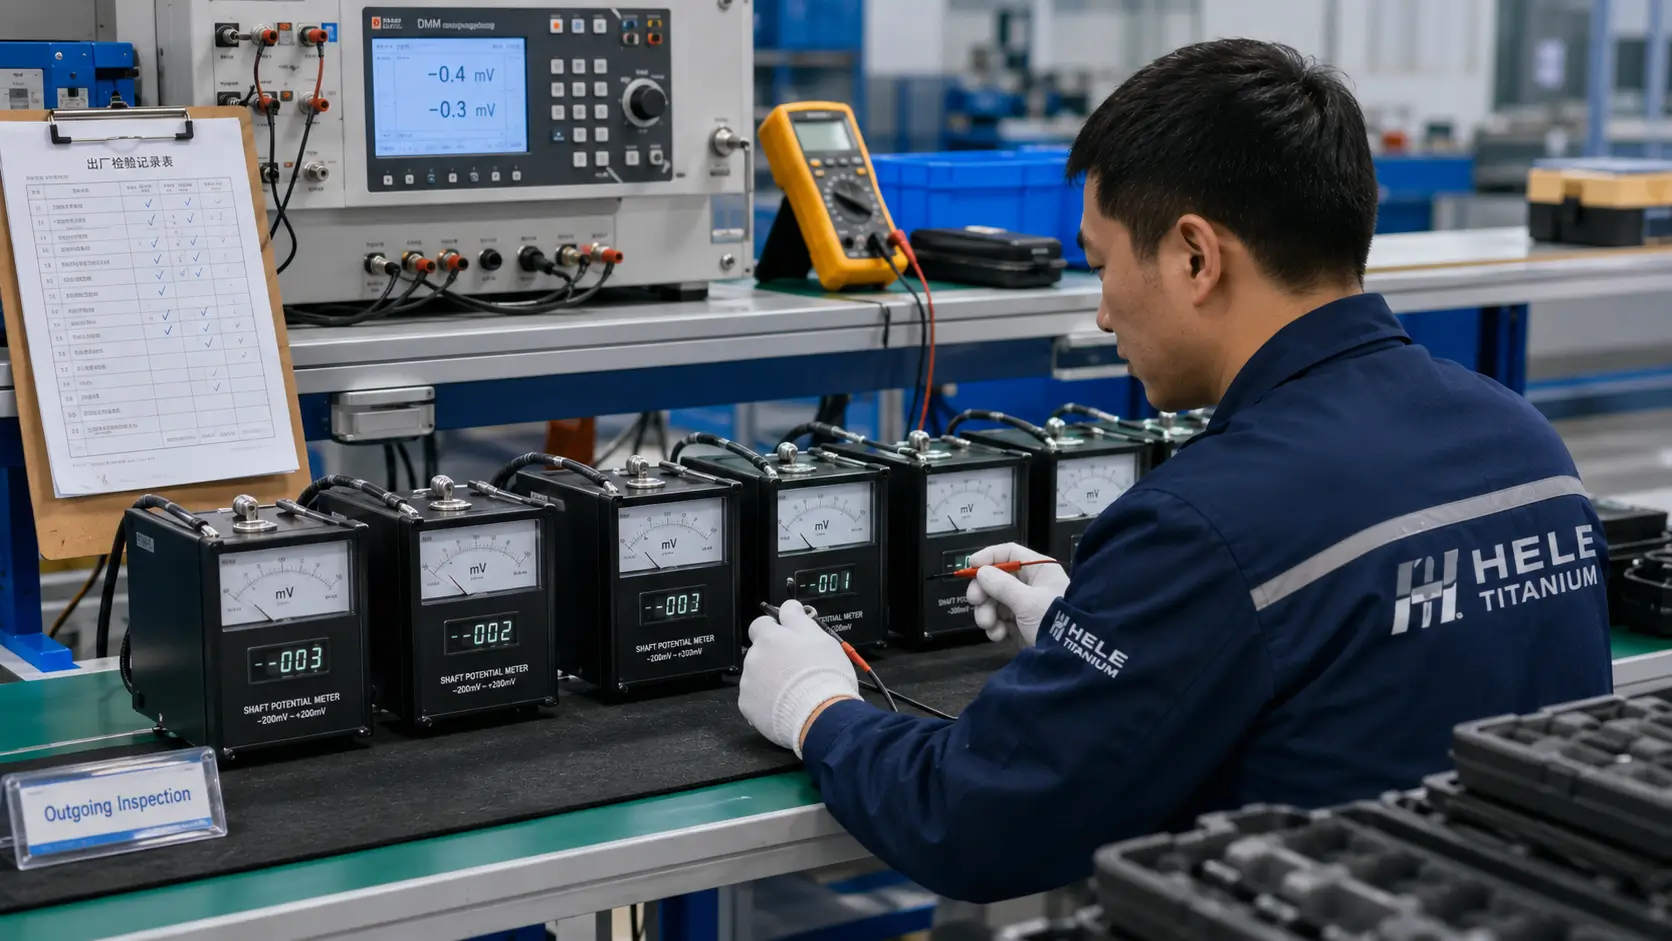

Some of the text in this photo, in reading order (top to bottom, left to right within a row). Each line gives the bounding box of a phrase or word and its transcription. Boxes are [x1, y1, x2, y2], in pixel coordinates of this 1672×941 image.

[417, 18, 441, 29] DMM
[428, 65, 495, 83] -0.4 mV
[429, 100, 496, 118] -0.3 mV
[87, 155, 174, 170] 出厂检验记录表
[1086, 488, 1100, 499] mV
[960, 503, 974, 514] mV
[814, 519, 830, 531] mV
[661, 537, 677, 550] mV
[1471, 523, 1597, 585] HELE
[469, 562, 487, 575] mV
[275, 586, 294, 600] mV
[1478, 564, 1599, 613] TITANIUM
[635, 634, 715, 653] SHAFT POTENTIAL METER
[1068, 622, 1128, 668] HELE
[1063, 637, 1120, 679] TITANIUM
[440, 663, 529, 685] SHAFT POTENTIAL METER
[243, 692, 340, 715] SHAFT POTENTIAL METER
[44, 787, 192, 823] Outgoing Inspection
